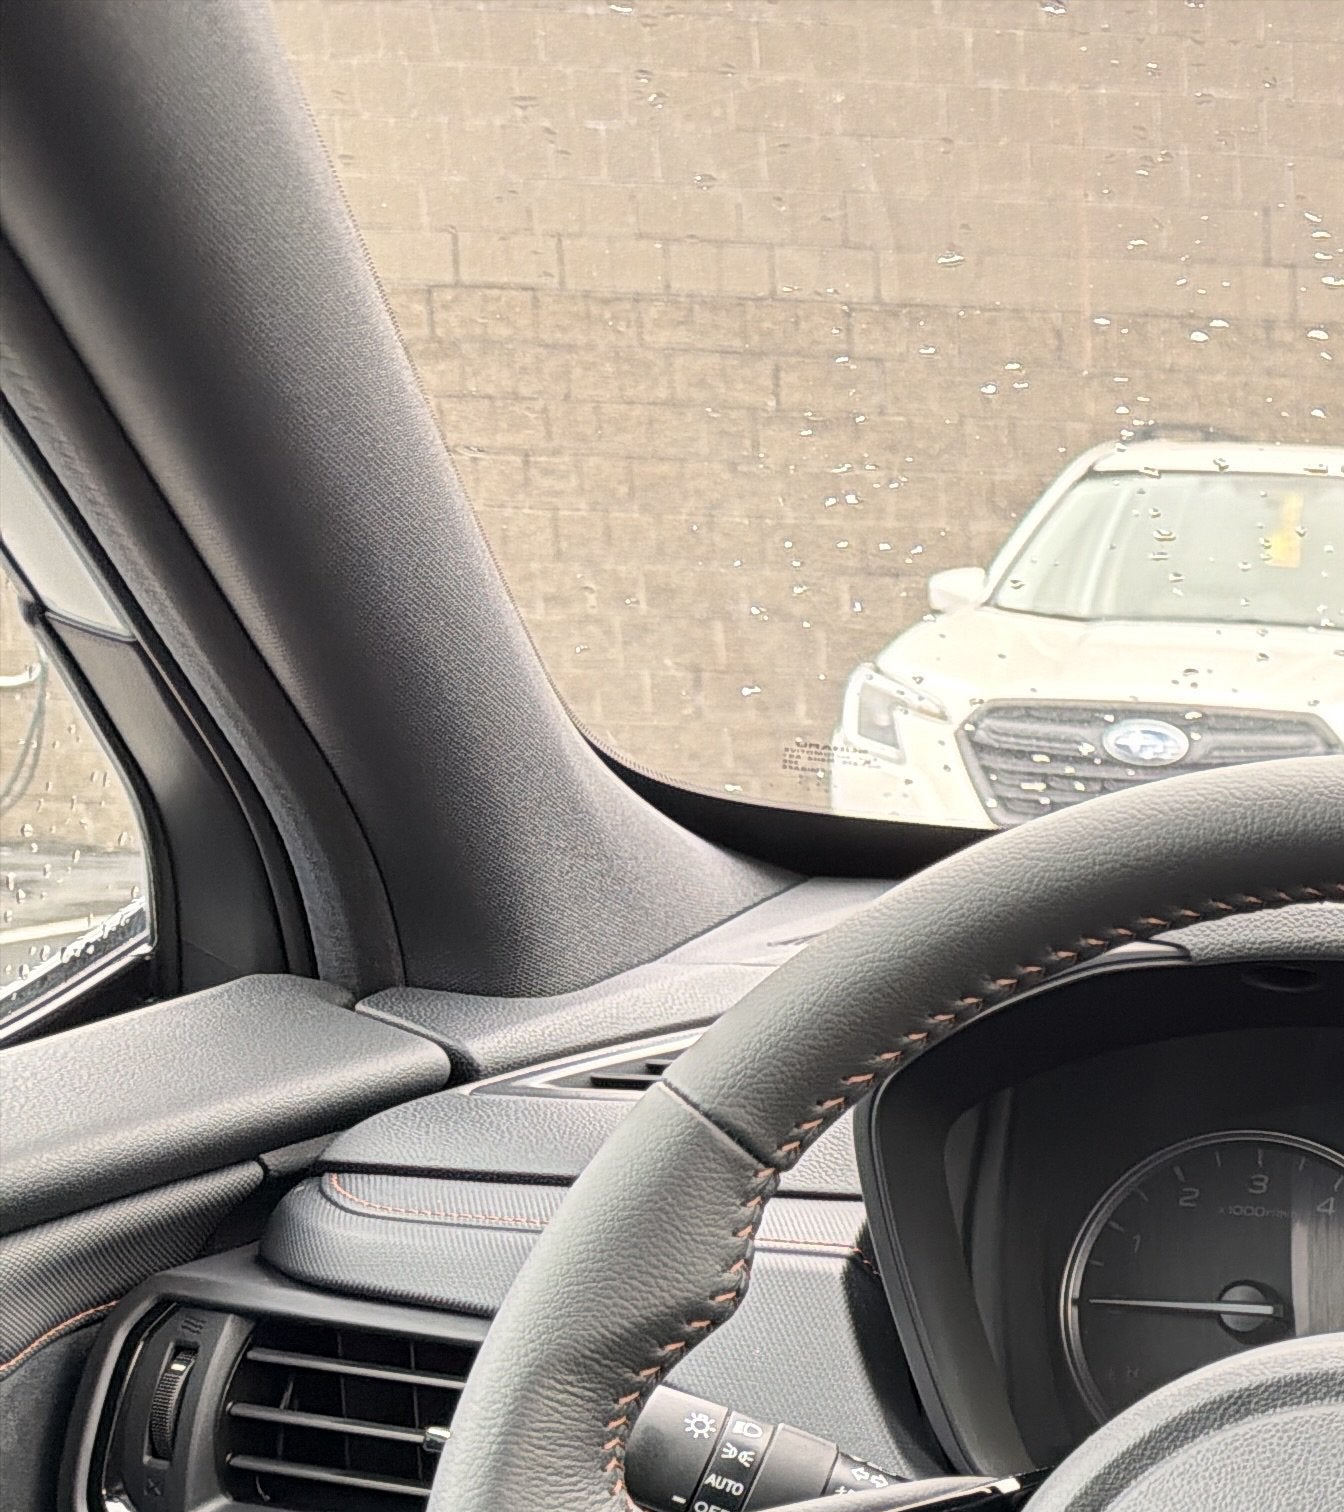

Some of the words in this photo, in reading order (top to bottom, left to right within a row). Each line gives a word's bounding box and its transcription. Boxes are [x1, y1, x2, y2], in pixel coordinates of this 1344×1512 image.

[1249, 1174, 1269, 1195] 3
[1178, 1187, 1200, 1208] 2
[1316, 1197, 1336, 1216] 4
[1133, 1233, 1142, 1254] 1
[704, 1473, 745, 1497] AUTO
